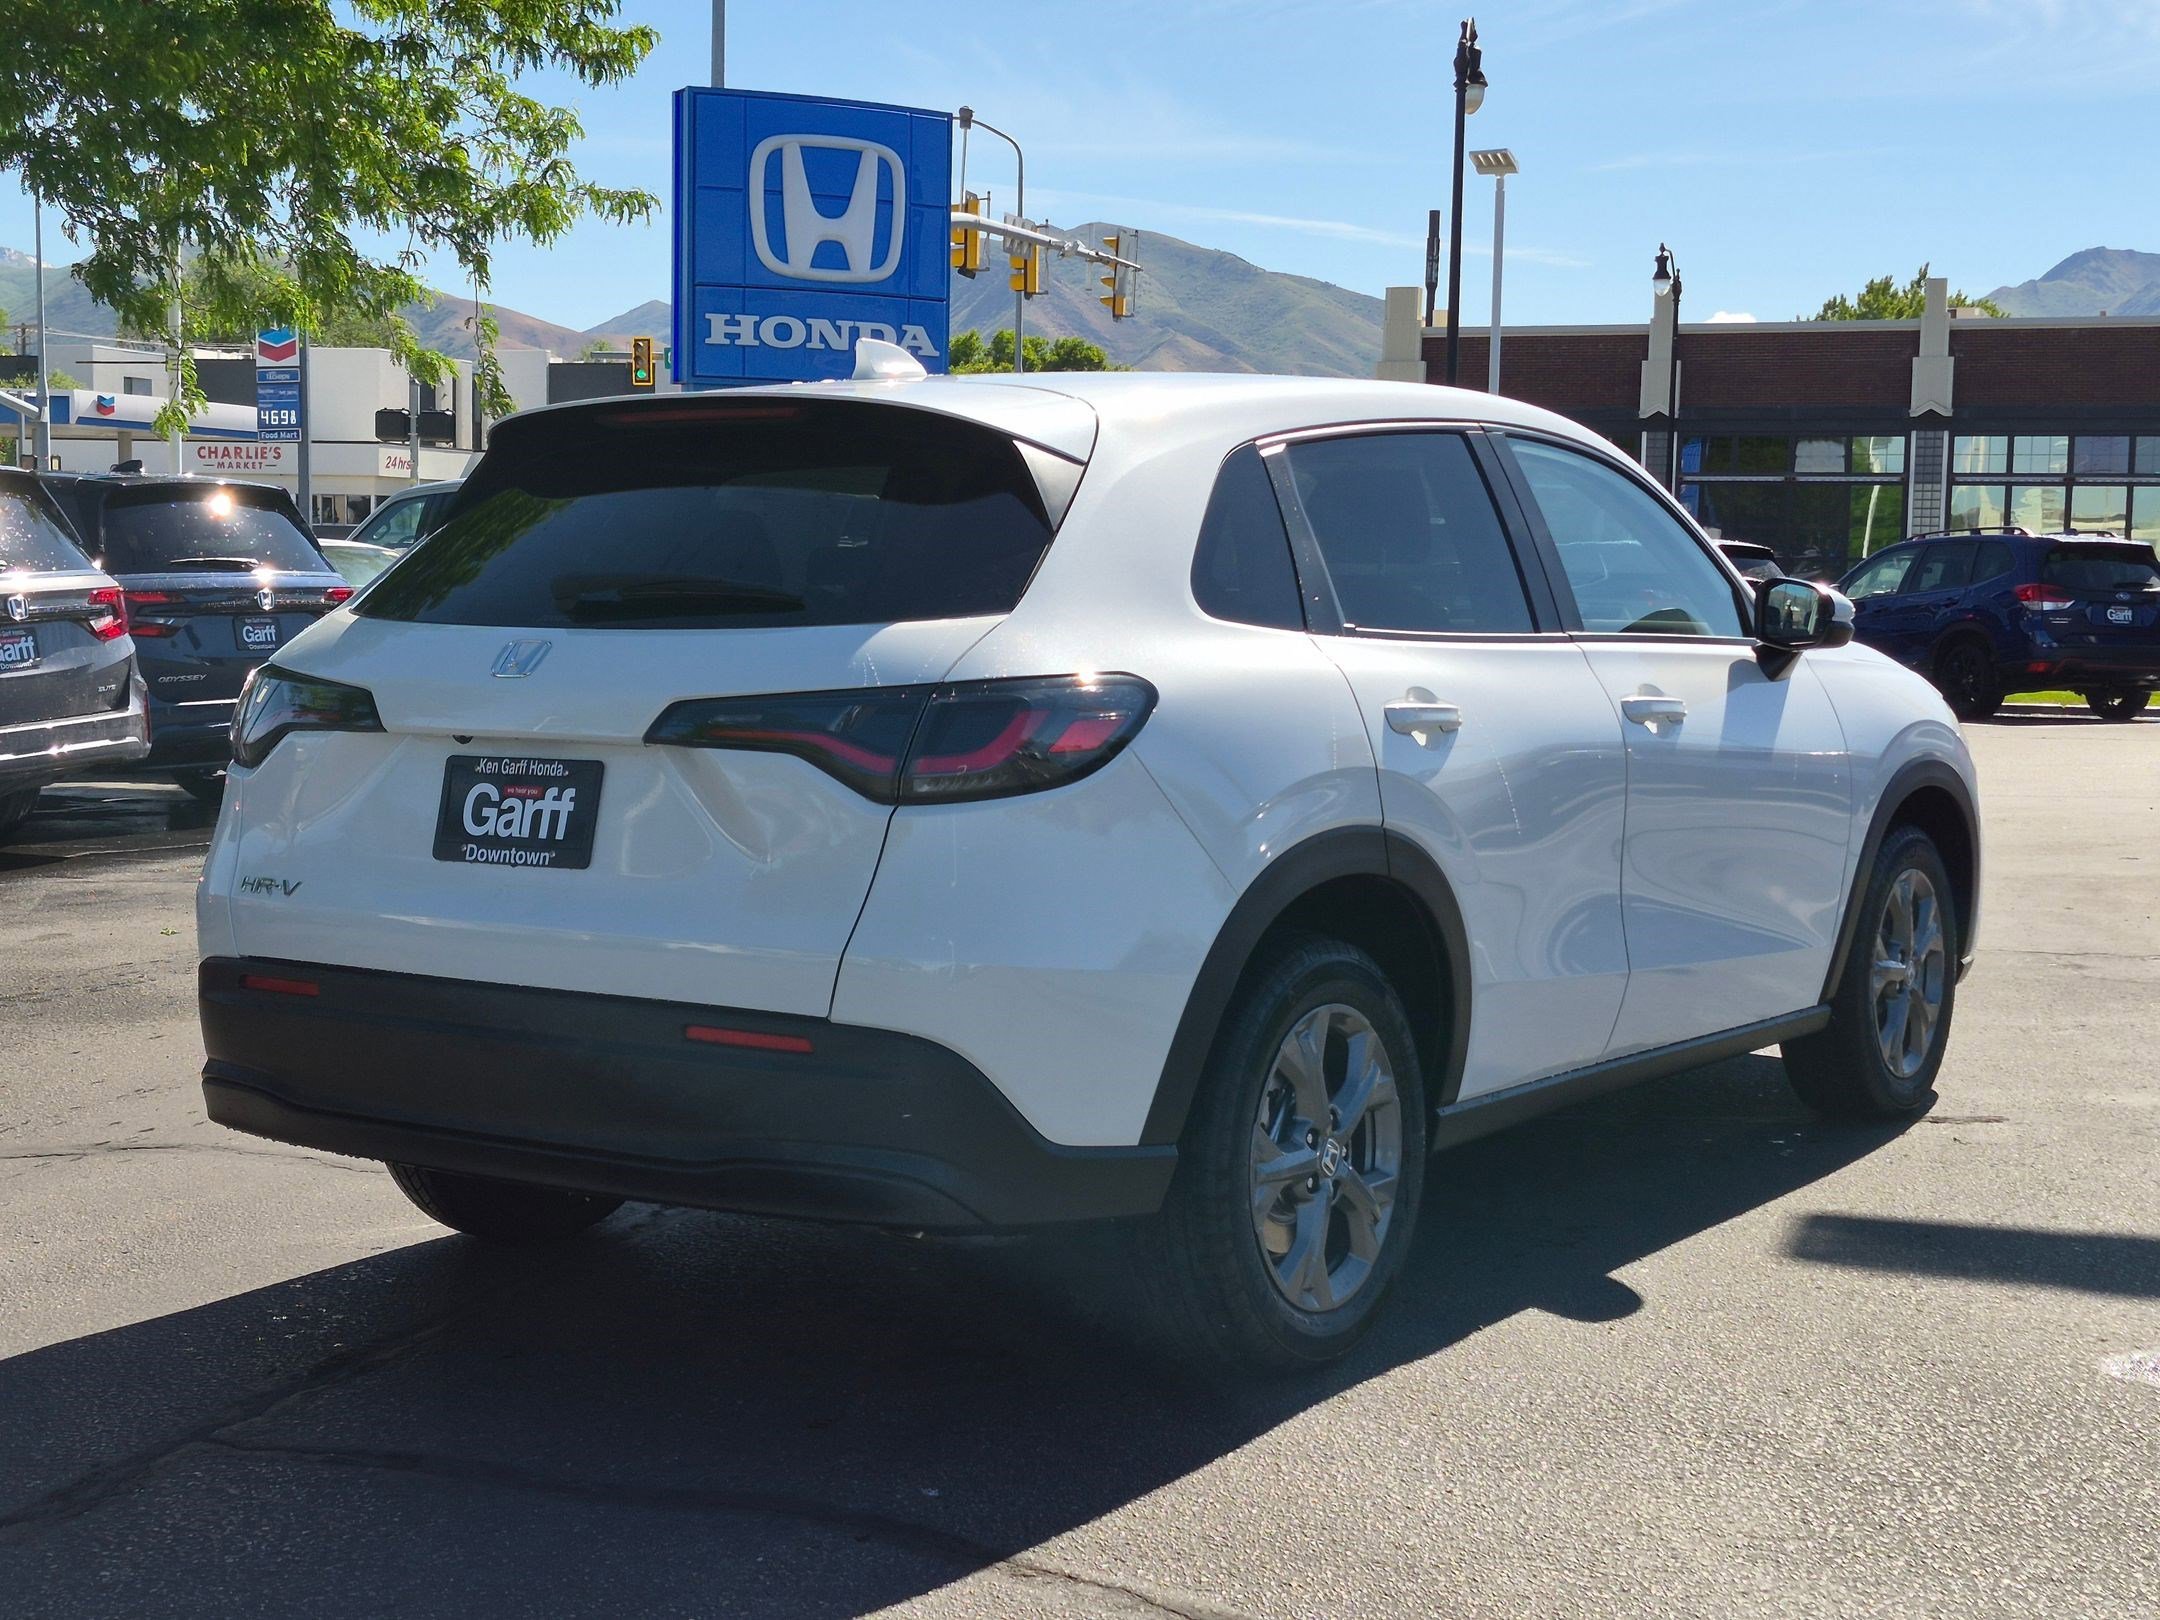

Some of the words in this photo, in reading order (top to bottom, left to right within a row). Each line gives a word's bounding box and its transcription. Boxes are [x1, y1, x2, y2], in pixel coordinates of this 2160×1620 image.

[704, 313, 940, 357] HONDA
[261, 432, 278, 440] Food
[280, 432, 298, 440] Mart
[197, 446, 282, 460] CHARLIE'S
[385, 455, 398, 469] 24
[217, 461, 264, 470] MARKET
[2106, 609, 2133, 621] Garff
[242, 625, 276, 643] Garff
[0, 636, 35, 662] arff
[158, 674, 207, 684] ODYSSEY
[479, 758, 499, 774] Ken
[501, 758, 528, 774] Garff
[528, 760, 564, 777] Honda
[462, 782, 576, 841] Garff
[465, 844, 551, 866] Downtown
[241, 876, 303, 897] HR-V
